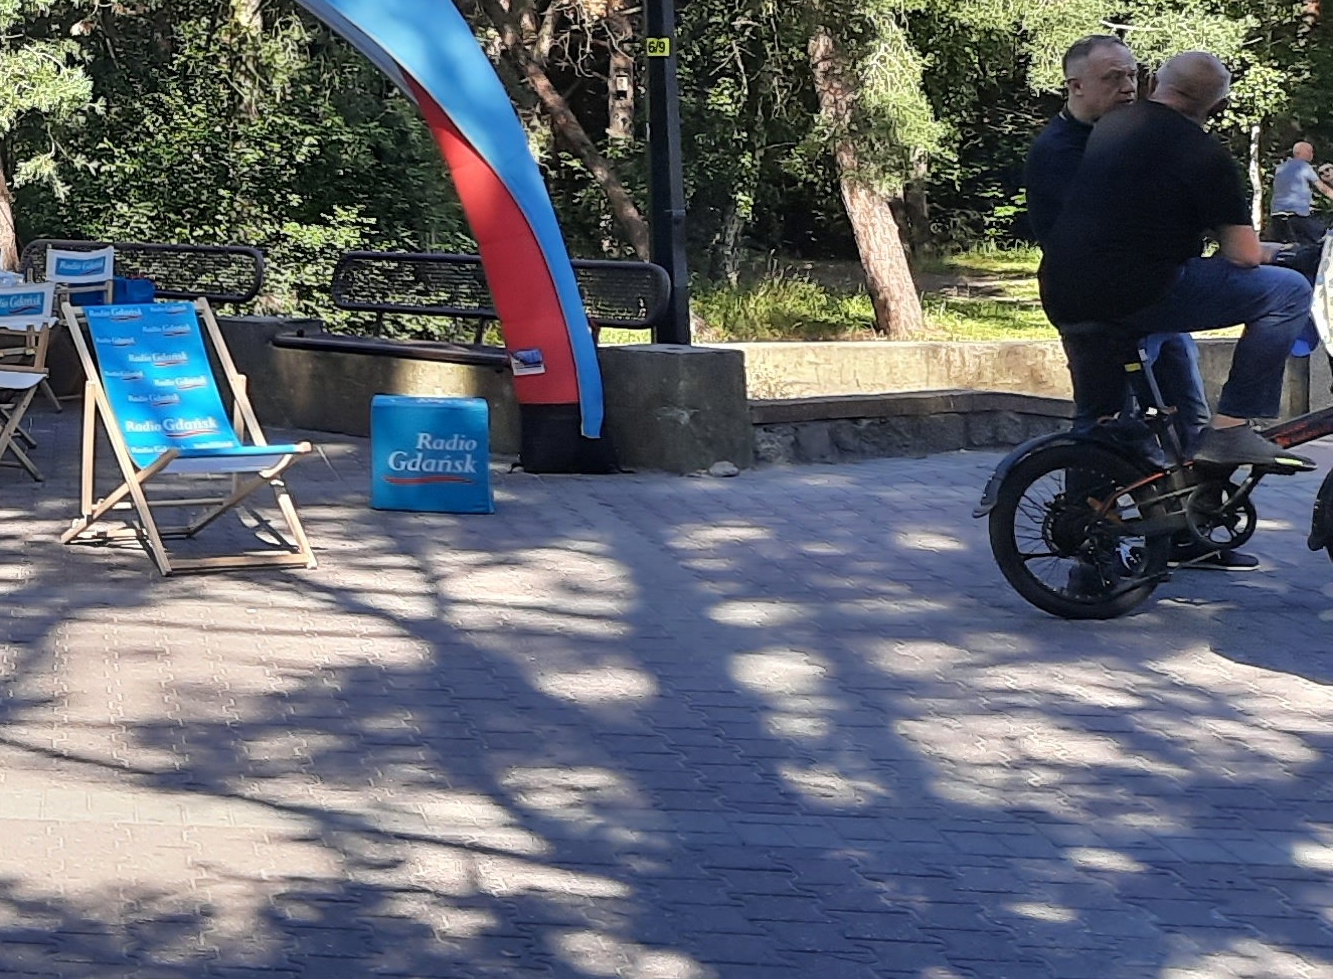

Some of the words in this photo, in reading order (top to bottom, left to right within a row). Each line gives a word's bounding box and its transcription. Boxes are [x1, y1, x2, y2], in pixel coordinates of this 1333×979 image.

[648, 40, 666, 53] 6/9
[124, 420, 162, 433] Radio
[162, 416, 219, 432] Gdańsk
[415, 432, 478, 451] Radio
[387, 450, 478, 474] Gdańsk
